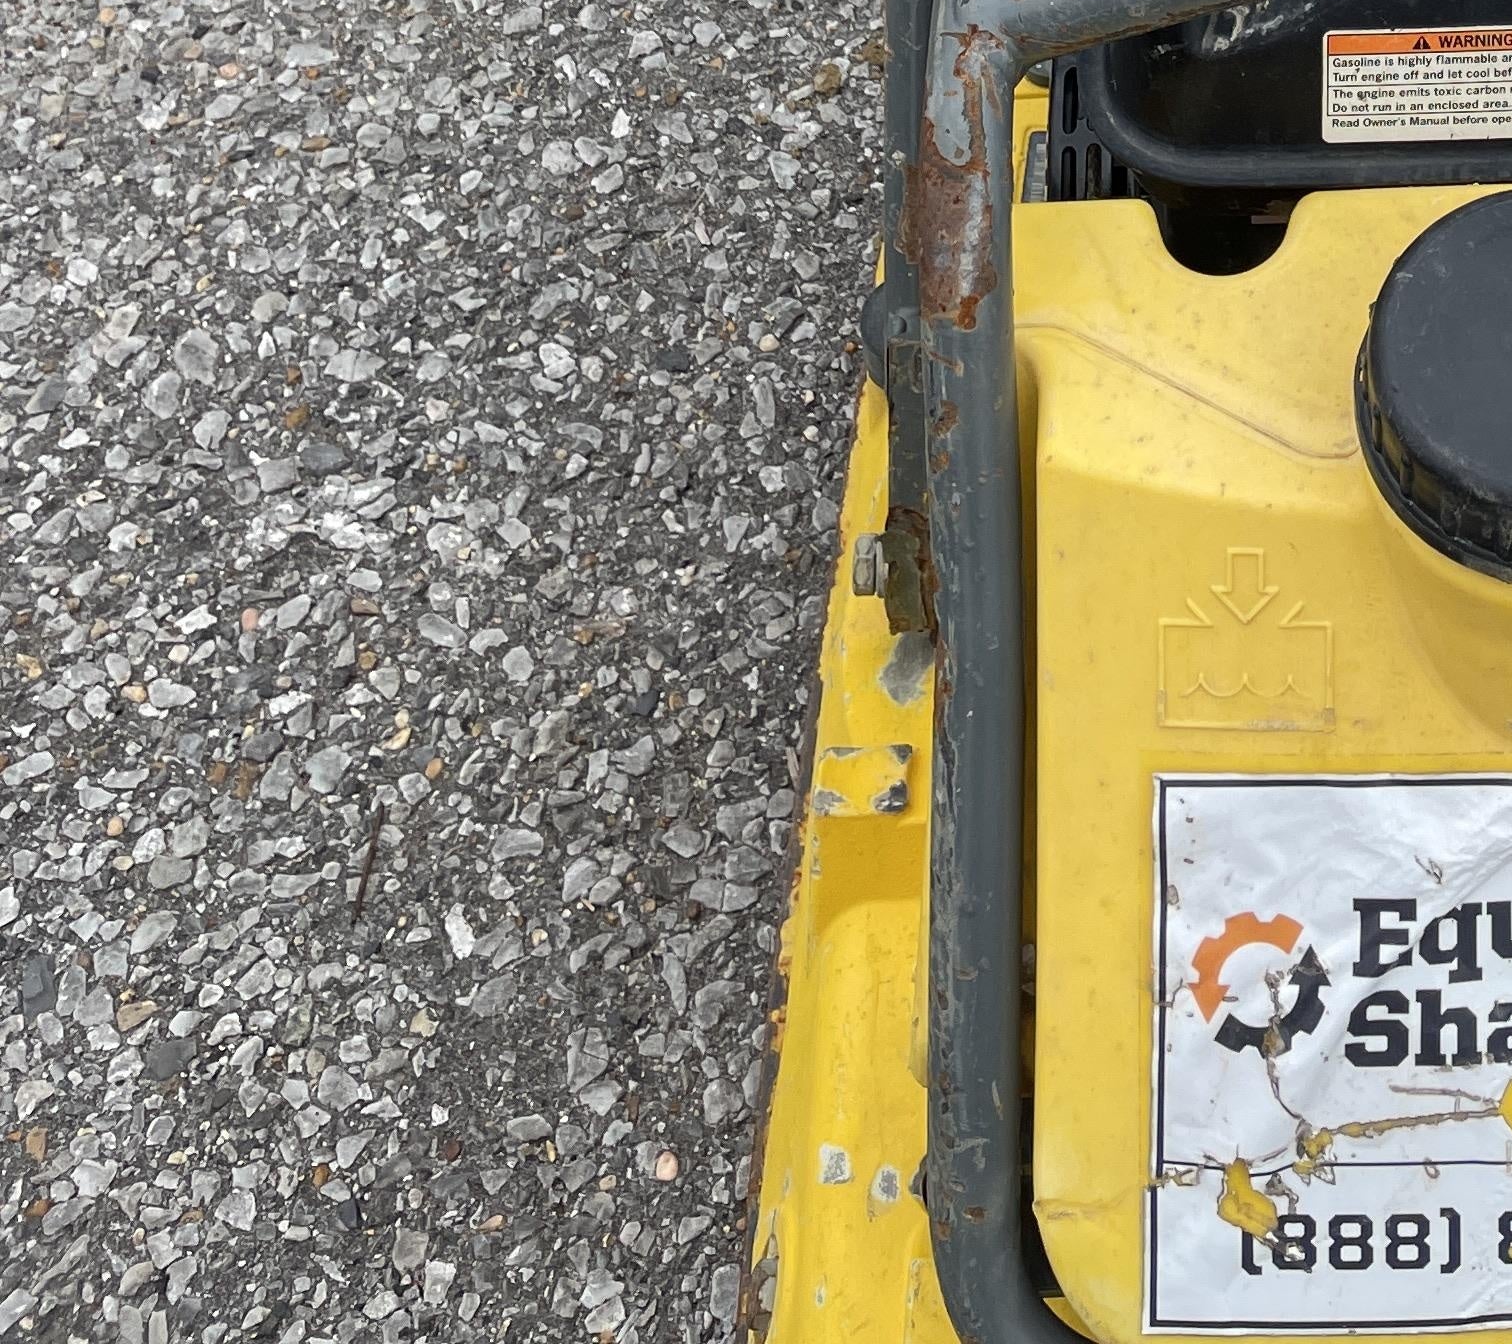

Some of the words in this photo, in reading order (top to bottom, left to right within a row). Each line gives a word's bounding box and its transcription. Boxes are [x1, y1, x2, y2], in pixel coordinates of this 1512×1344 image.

[1333, 57, 1381, 69] Gasoline
[1384, 57, 1395, 66] is
[1397, 55, 1432, 68] highly
[1436, 54, 1498, 65] flammable
[1333, 72, 1357, 82] Turn
[1361, 72, 1400, 84] engine
[1403, 70, 1419, 79] off
[1423, 69, 1444, 79] and
[1448, 69, 1464, 79] let
[1466, 68, 1490, 78] cool
[1333, 89, 1353, 99] The
[1357, 88, 1395, 100] engine
[1399, 87, 1430, 97] emits
[1434, 86, 1462, 96] toxic
[1466, 85, 1505, 95] carbon
[1333, 103, 1347, 113] Do
[1351, 102, 1369, 112] not
[1372, 102, 1392, 111] run
[1396, 101, 1406, 110] in
[1410, 102, 1424, 110] an
[1428, 99, 1479, 109] enclosed
[1483, 100, 1512, 108] area.
[1332, 118, 1360, 127] Read
[1363, 117, 1406, 127] Owner's
[1410, 116, 1450, 126] Manual
[1453, 115, 1488, 125] before
[1240, 1207, 1462, 1275] (888)
